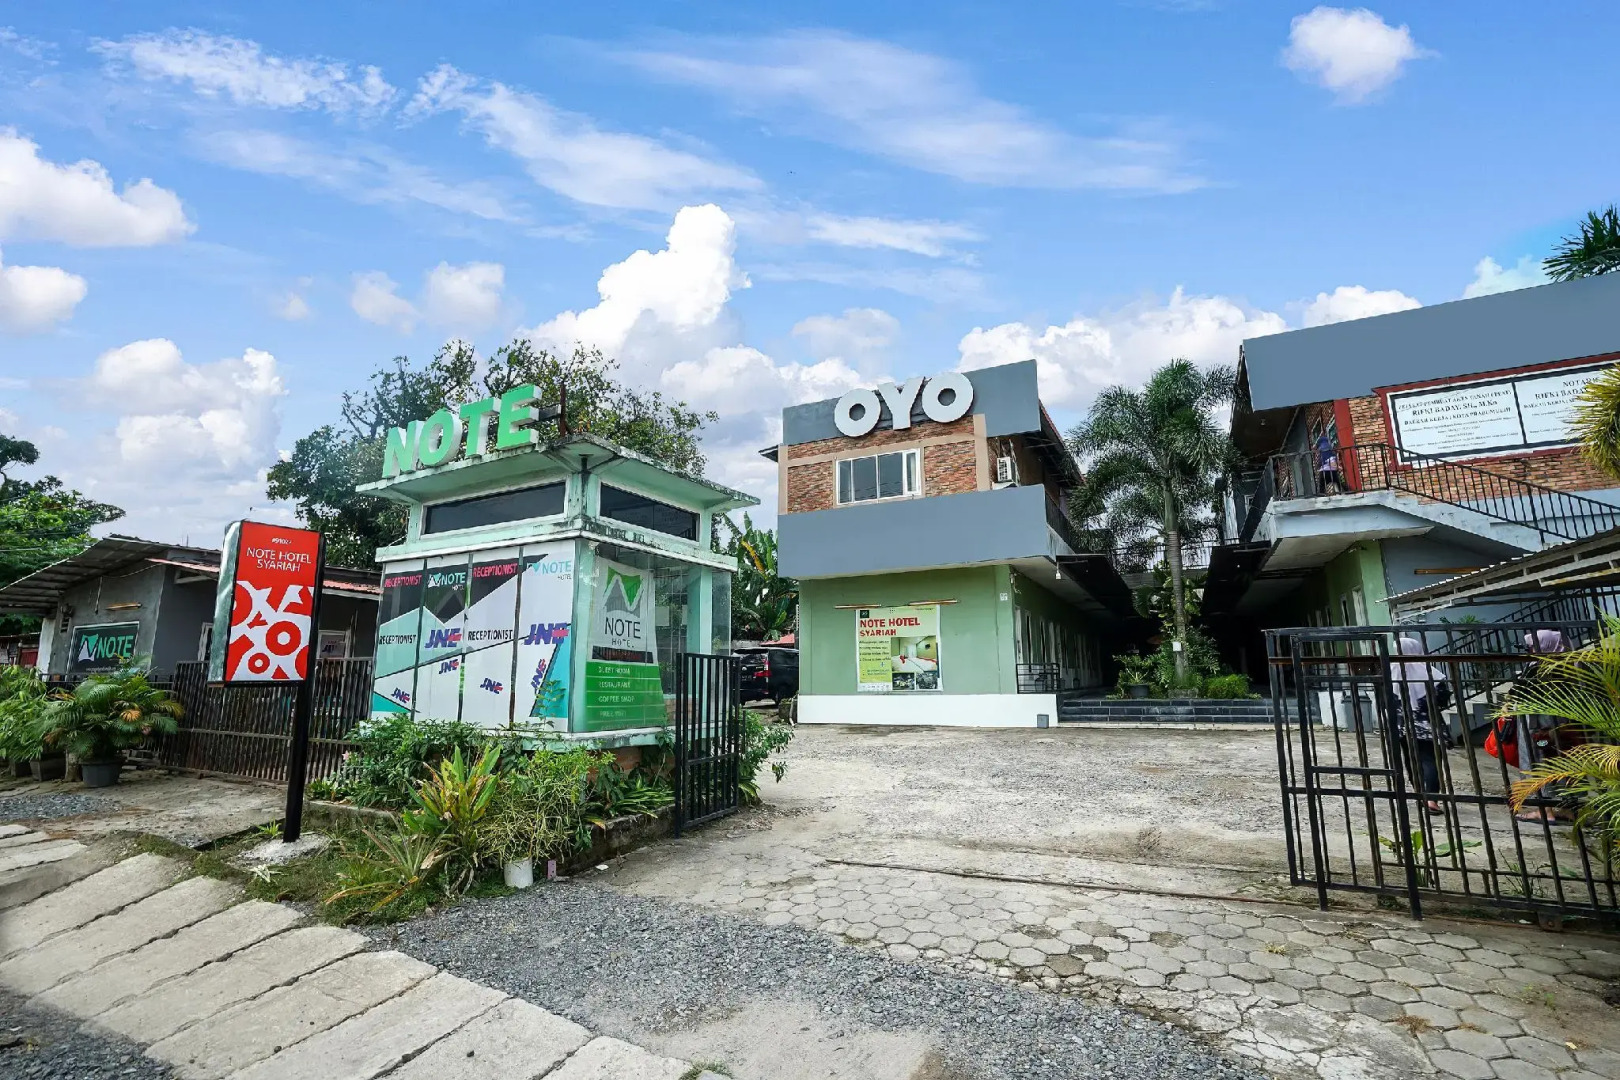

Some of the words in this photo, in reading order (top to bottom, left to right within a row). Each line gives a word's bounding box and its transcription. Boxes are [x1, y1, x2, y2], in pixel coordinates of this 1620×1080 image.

[834, 371, 974, 437] OYO
[382, 383, 542, 479] NOTE
[246, 547, 276, 560] NOTE
[279, 551, 312, 564] HOTEL
[257, 559, 300, 572] SYARIAH
[473, 563, 518, 578] RECEPTIONIST
[542, 560, 572, 574] NOTE
[384, 574, 422, 588] RECEPTIONIST
[441, 572, 466, 585] NOTE
[605, 617, 641, 639] NOTE
[860, 618, 885, 628] NOTE
[888, 617, 920, 627] HOTEL
[378, 634, 417, 645] RECEPTIONIST
[424, 627, 462, 648] JNE
[468, 629, 514, 641] RECEPTIONIST
[523, 622, 570, 645] JNE
[860, 629, 896, 637] SYARIAH
[96, 635, 134, 658] NOTE
[439, 659, 459, 674] JNE
[480, 677, 503, 694] JNE
[391, 687, 411, 704] JNE
